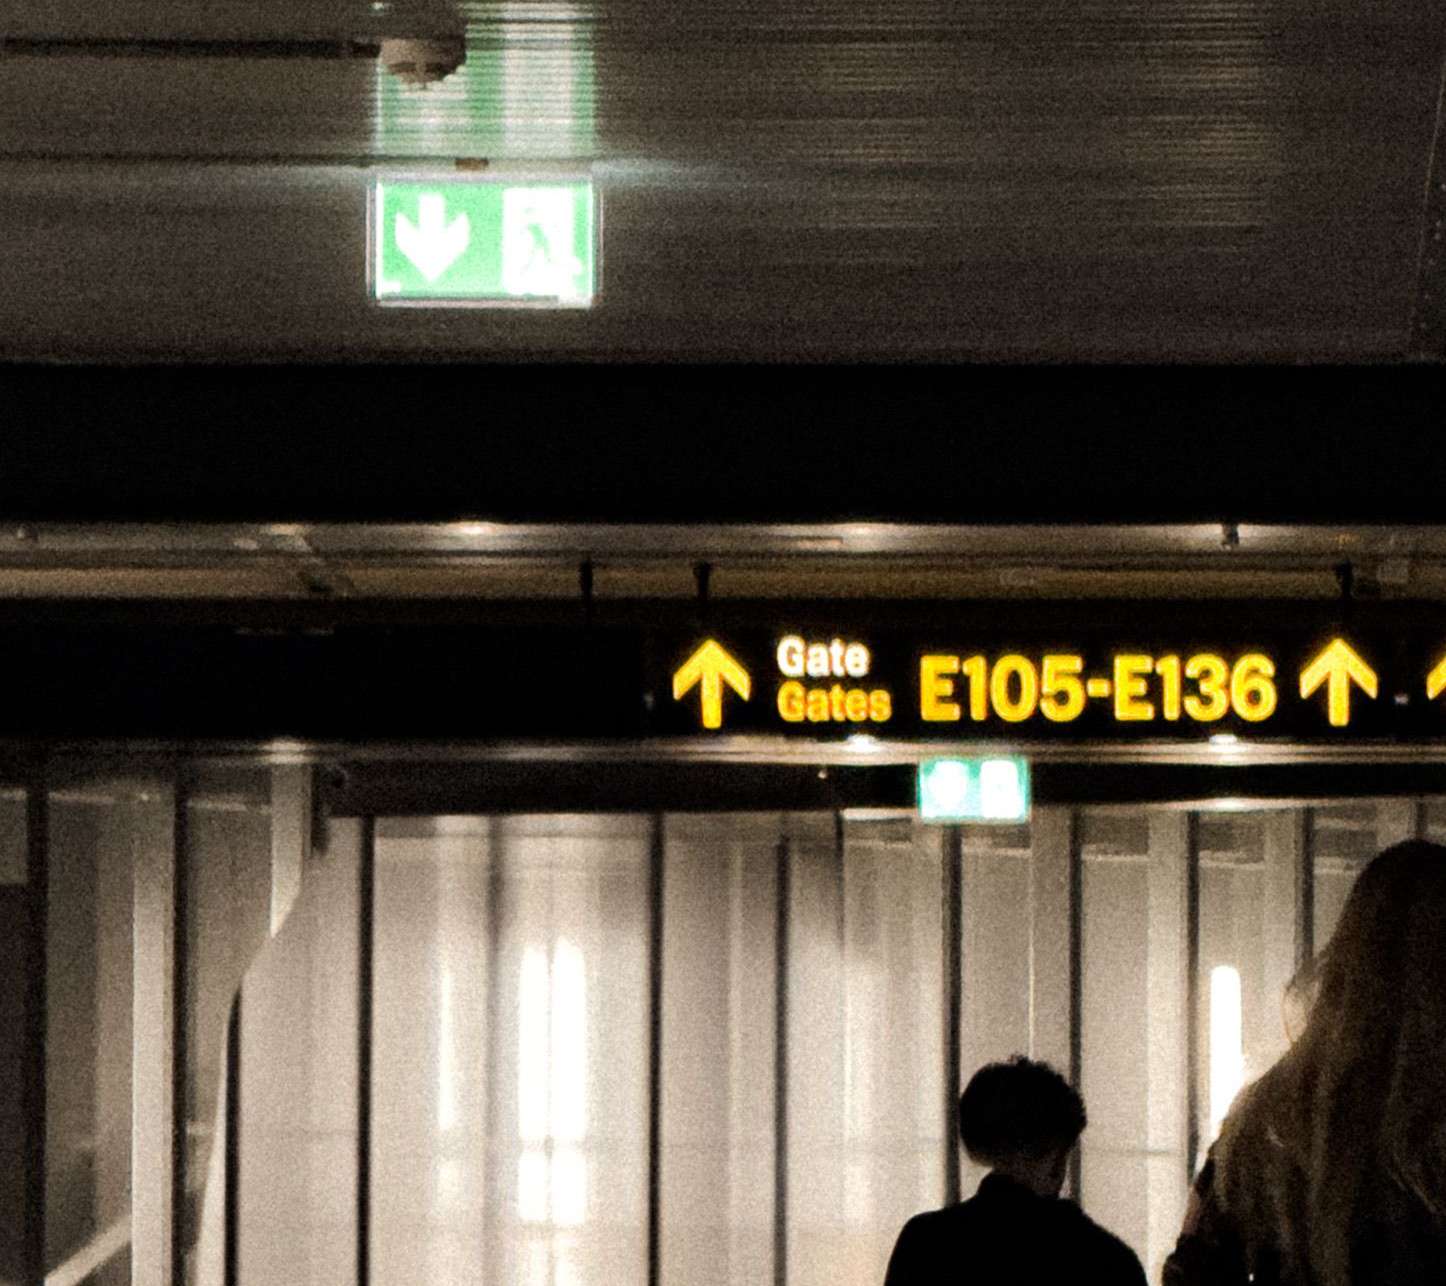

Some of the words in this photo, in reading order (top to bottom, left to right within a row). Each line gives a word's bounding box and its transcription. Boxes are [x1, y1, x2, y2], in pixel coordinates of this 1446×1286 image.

[777, 635, 870, 677] Gate
[777, 680, 892, 722] Gates
[919, 653, 1277, 722] E105-E136
